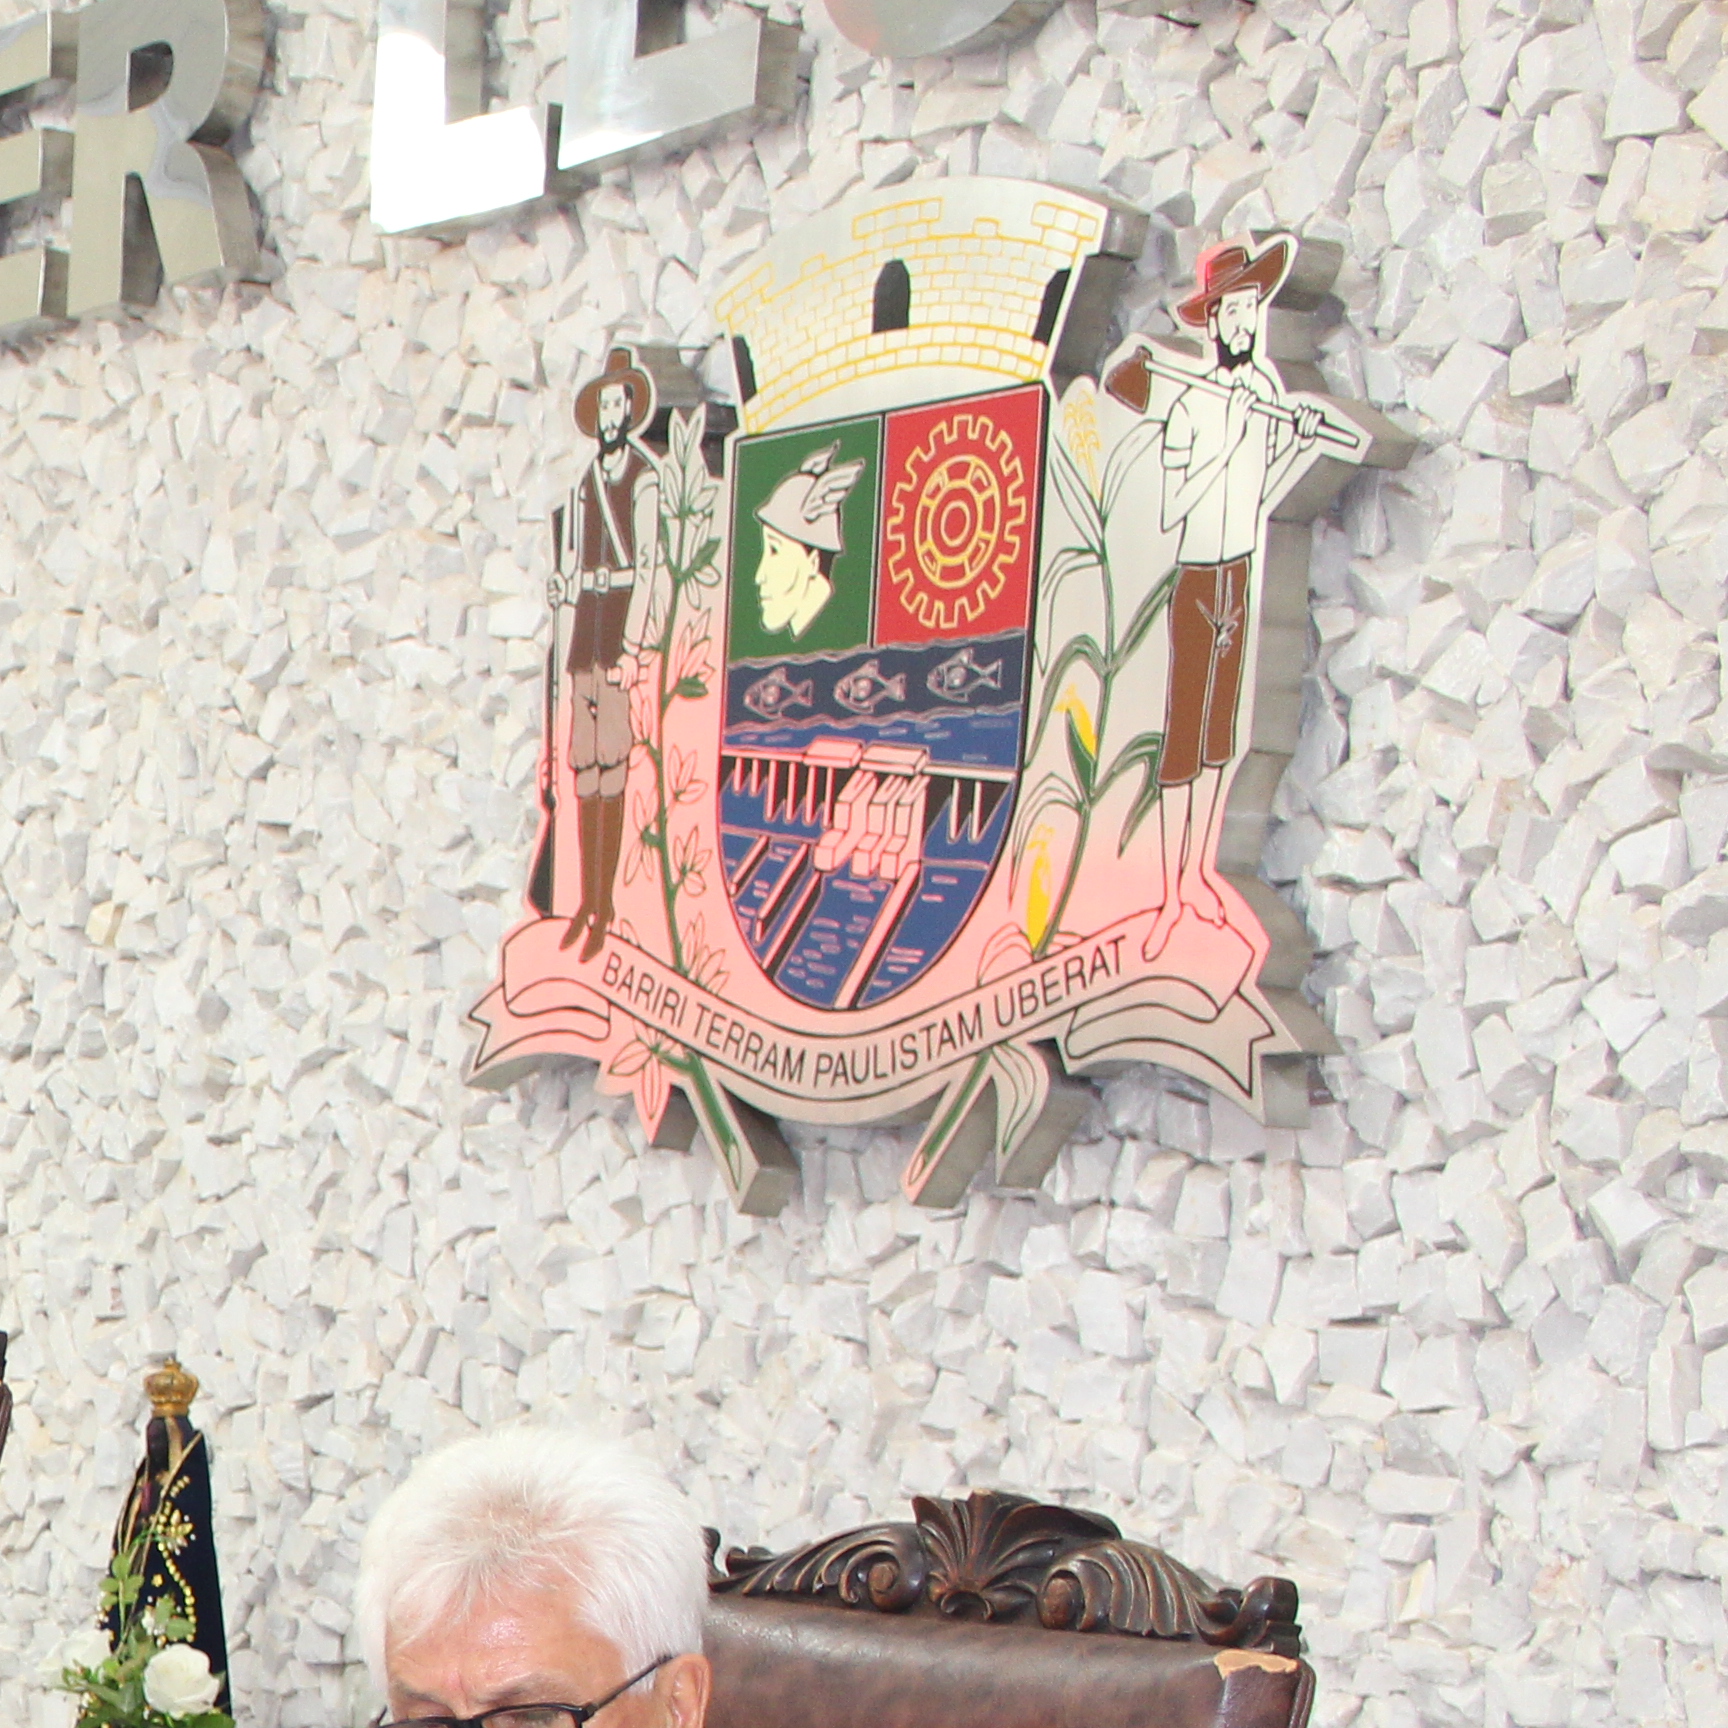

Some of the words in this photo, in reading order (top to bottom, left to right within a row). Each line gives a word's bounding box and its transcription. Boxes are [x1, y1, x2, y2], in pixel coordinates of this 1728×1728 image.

[602, 951, 688, 1028] BARIRI
[694, 1002, 806, 1084] TERRAM
[813, 1002, 984, 1088] PAULISTAM
[994, 935, 1126, 1028] UBERAT
